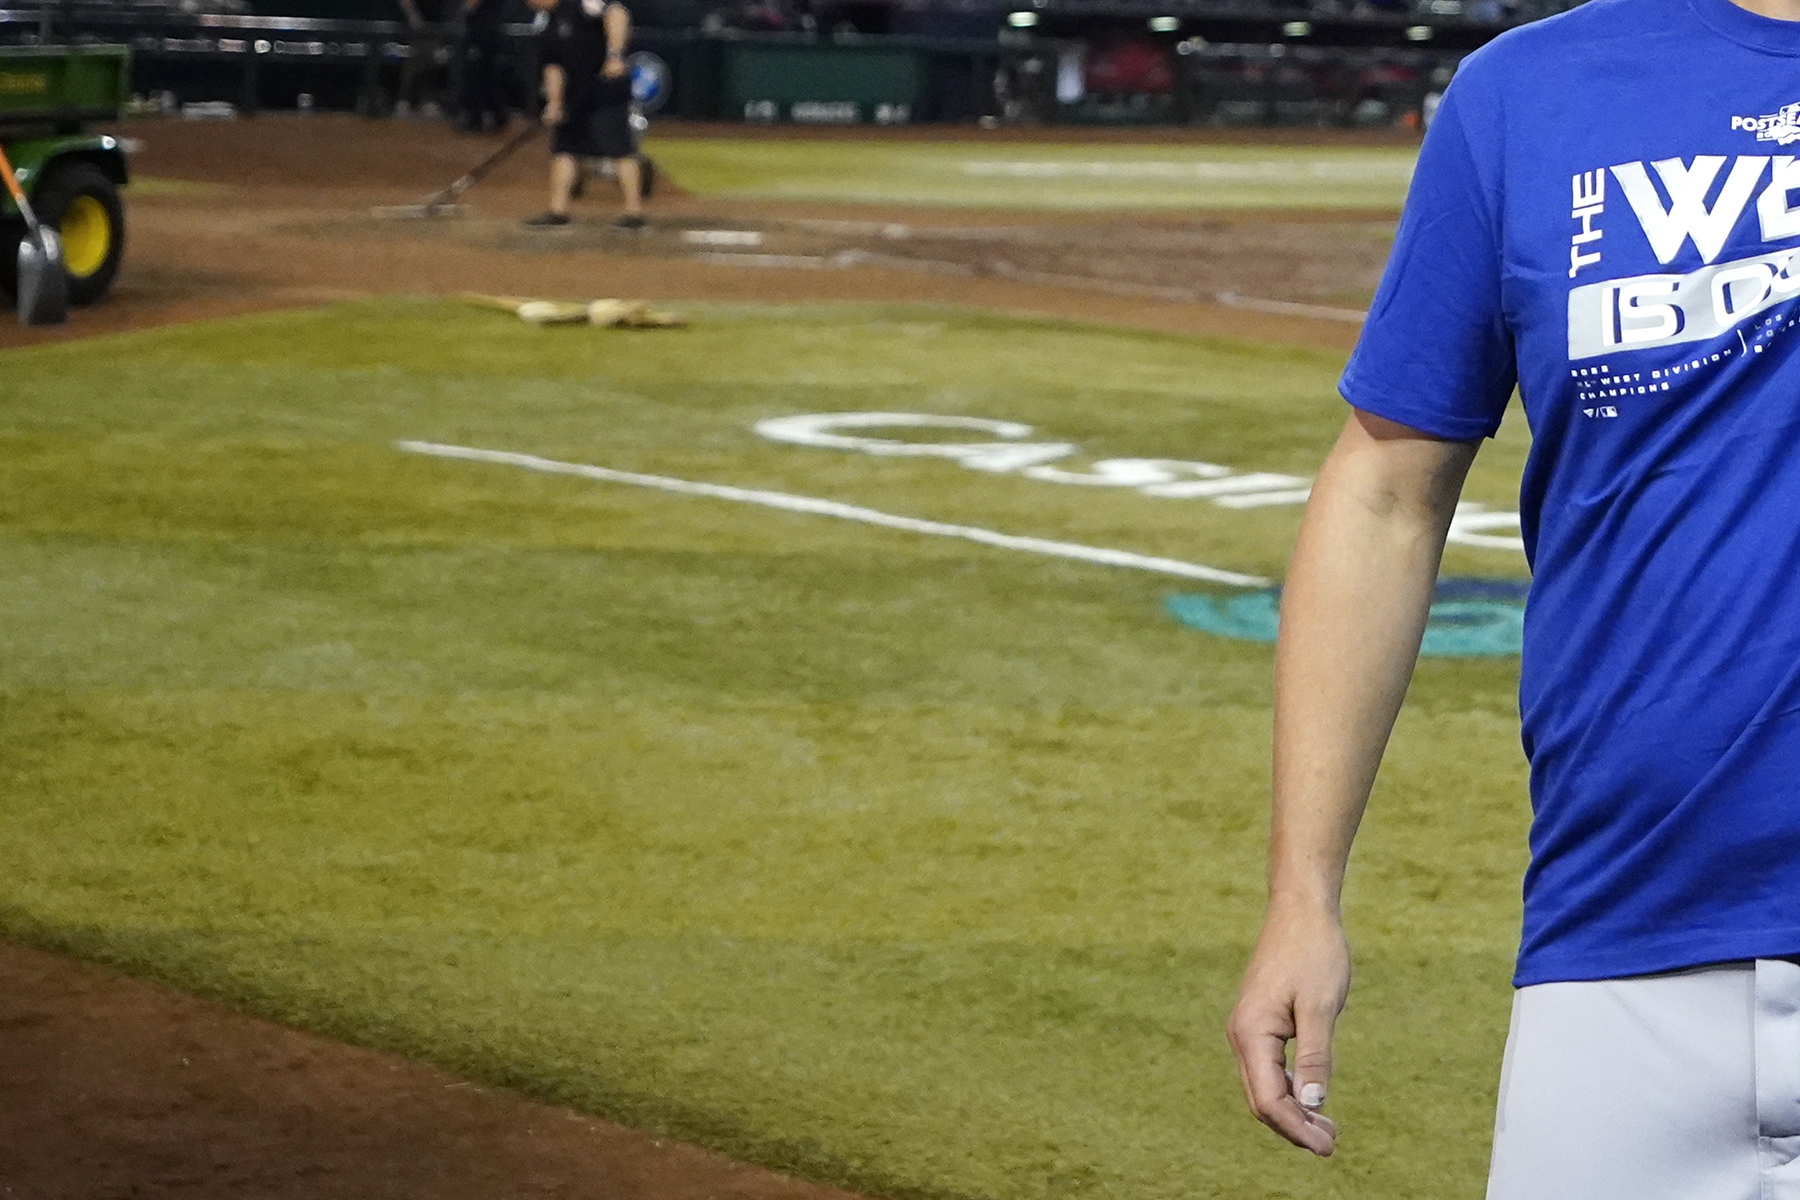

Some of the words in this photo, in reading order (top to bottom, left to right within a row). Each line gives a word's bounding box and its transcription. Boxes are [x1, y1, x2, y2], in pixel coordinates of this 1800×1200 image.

[1569, 167, 1605, 278] THE
[1602, 281, 1686, 348] IS
[1580, 381, 1670, 400] CHAMPIONS
[1600, 373, 1641, 386] WEST
[1651, 349, 1732, 379] DIVISION
